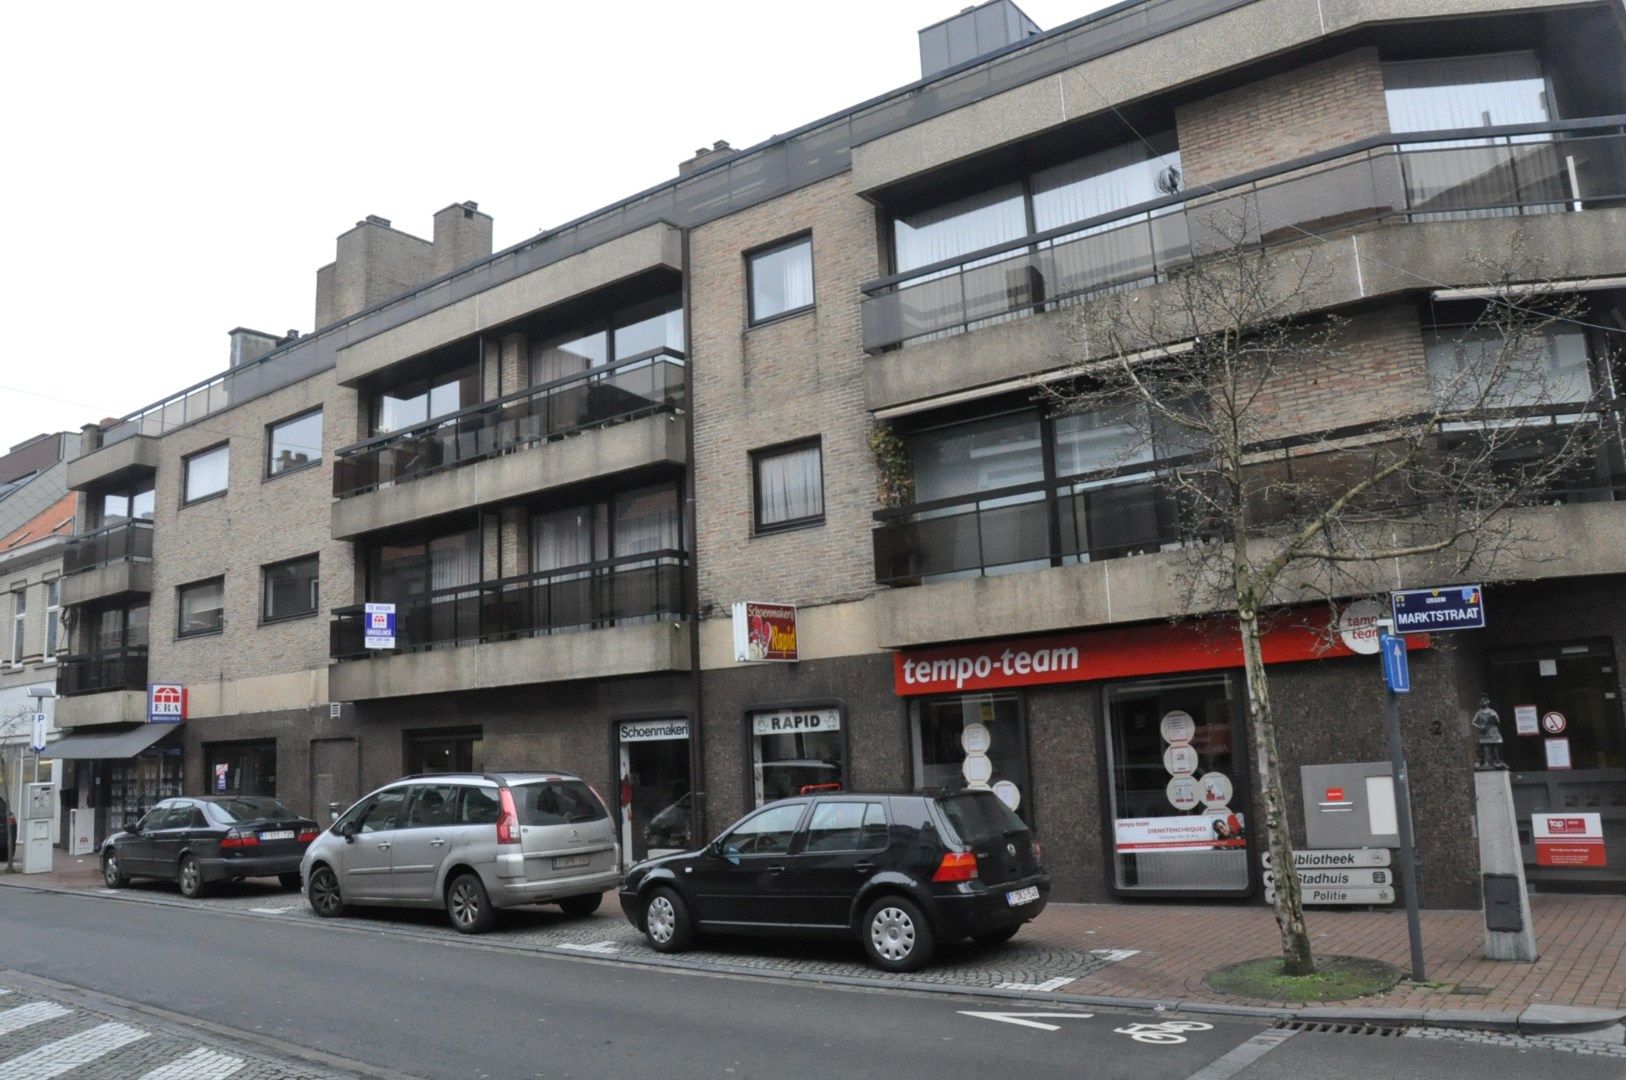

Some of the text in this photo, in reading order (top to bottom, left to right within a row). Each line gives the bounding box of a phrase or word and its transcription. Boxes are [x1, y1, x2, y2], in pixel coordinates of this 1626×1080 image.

[1398, 607, 1479, 625] MARKTSTRAAT
[771, 624, 796, 658] Rapid
[903, 646, 1078, 688] tempo-team
[154, 703, 179, 712] ERA
[771, 715, 820, 730] RAPID
[1294, 853, 1355, 865] ibliotheek
[1313, 890, 1348, 901] Politie
